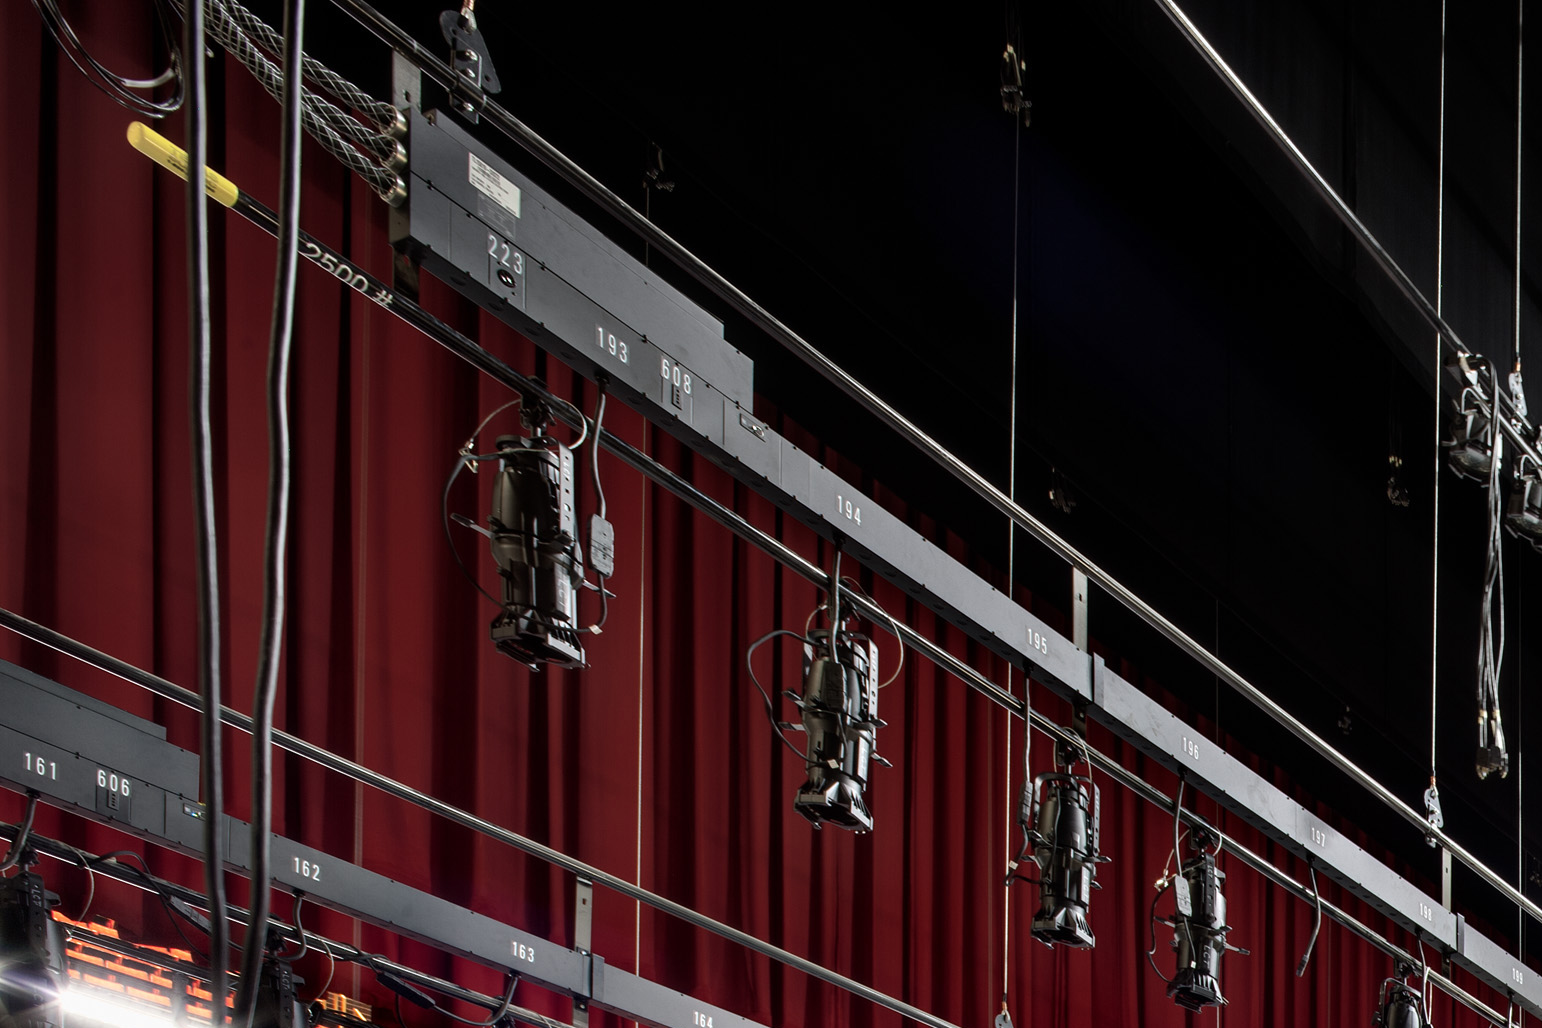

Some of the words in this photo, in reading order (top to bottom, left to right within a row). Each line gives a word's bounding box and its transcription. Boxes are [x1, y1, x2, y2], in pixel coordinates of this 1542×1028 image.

[302, 243, 369, 293] 2500
[488, 234, 524, 275] 223
[598, 327, 629, 364] 193
[662, 358, 692, 395] 608
[837, 495, 862, 526] 194
[1028, 628, 1048, 655] 195
[1182, 737, 1200, 760] 196
[25, 752, 57, 780] 161
[97, 769, 131, 798] 606
[1311, 827, 1326, 848] 197
[294, 857, 321, 881] 162
[512, 941, 536, 963] 163
[1203, 944, 1211, 970] LCT
